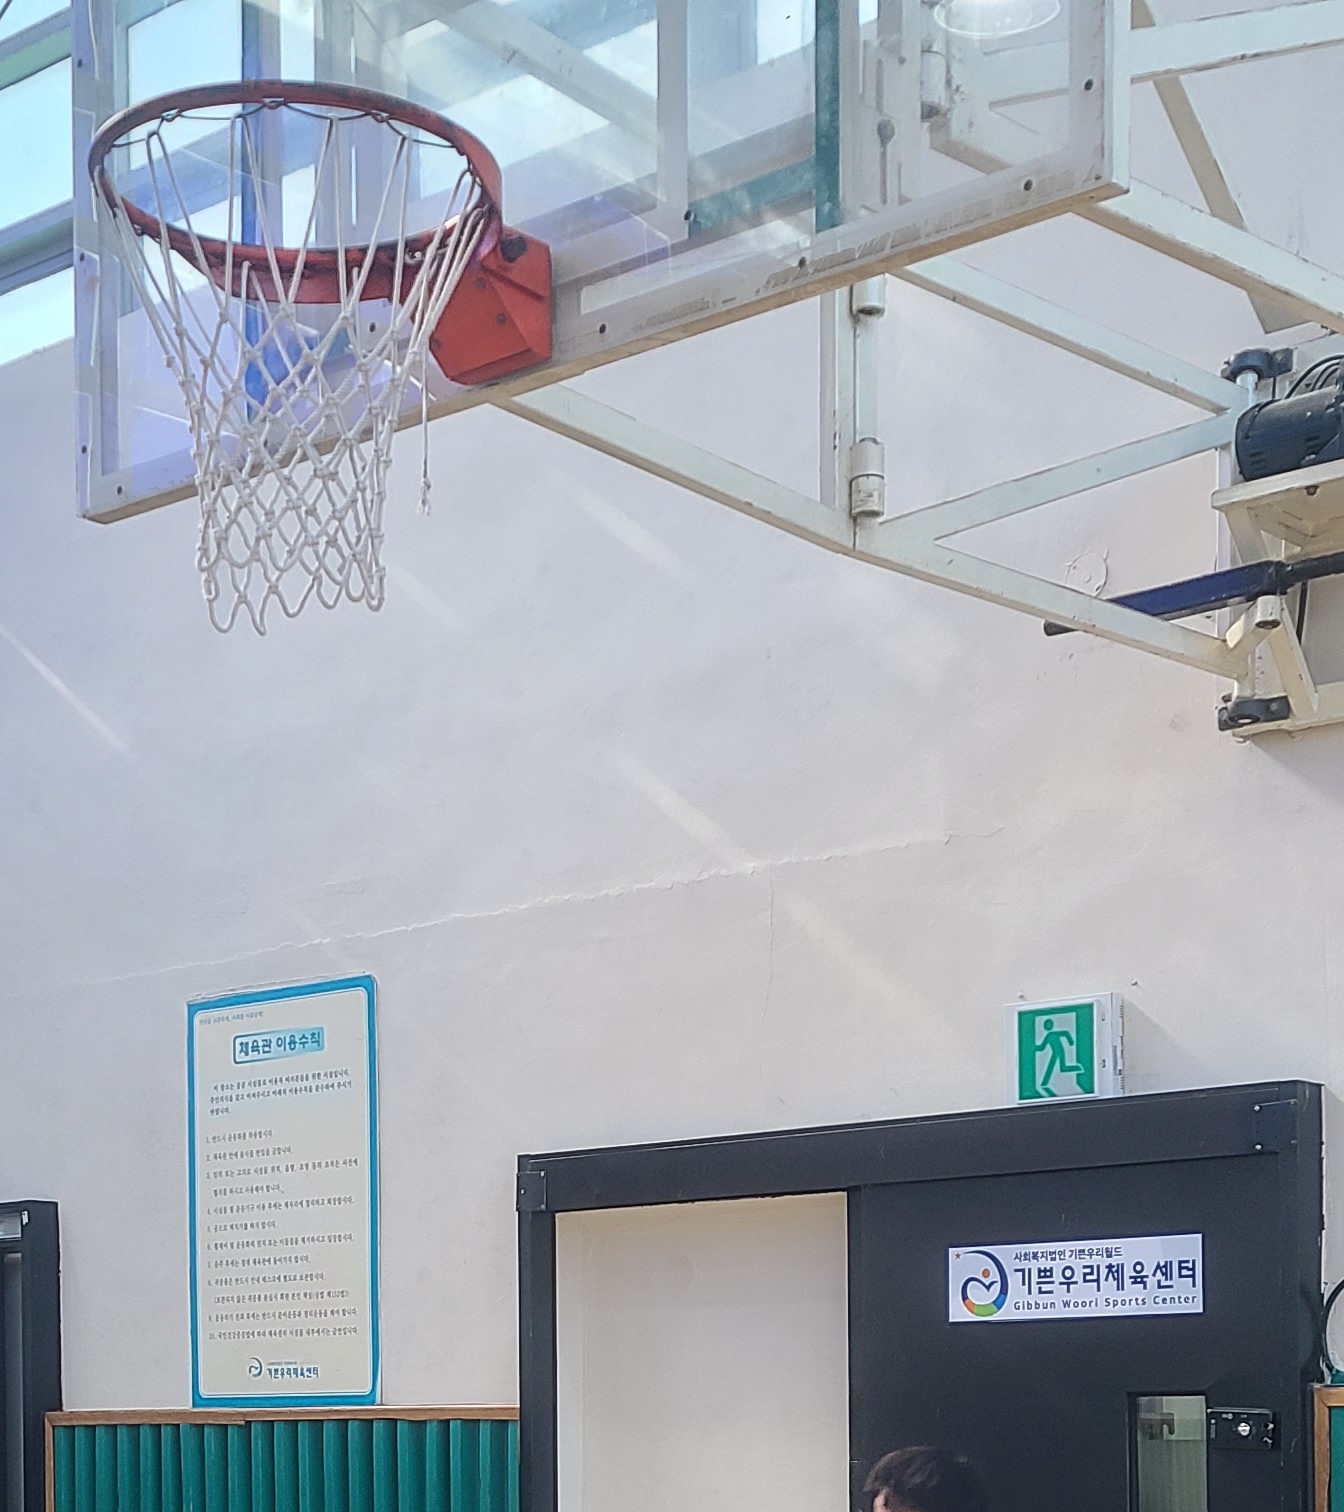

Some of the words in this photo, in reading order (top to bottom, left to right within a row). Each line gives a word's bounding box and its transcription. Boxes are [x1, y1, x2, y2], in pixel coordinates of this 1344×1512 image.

[239, 1038, 273, 1057] 체육관
[276, 1031, 321, 1052] 이용수칙
[1013, 1259, 1197, 1295] 기쁜우리체육센터
[1013, 1300, 1056, 1311] Gibbun
[1062, 1298, 1099, 1309] Woori
[1104, 1297, 1147, 1310] Sports
[1153, 1294, 1198, 1305] Center
